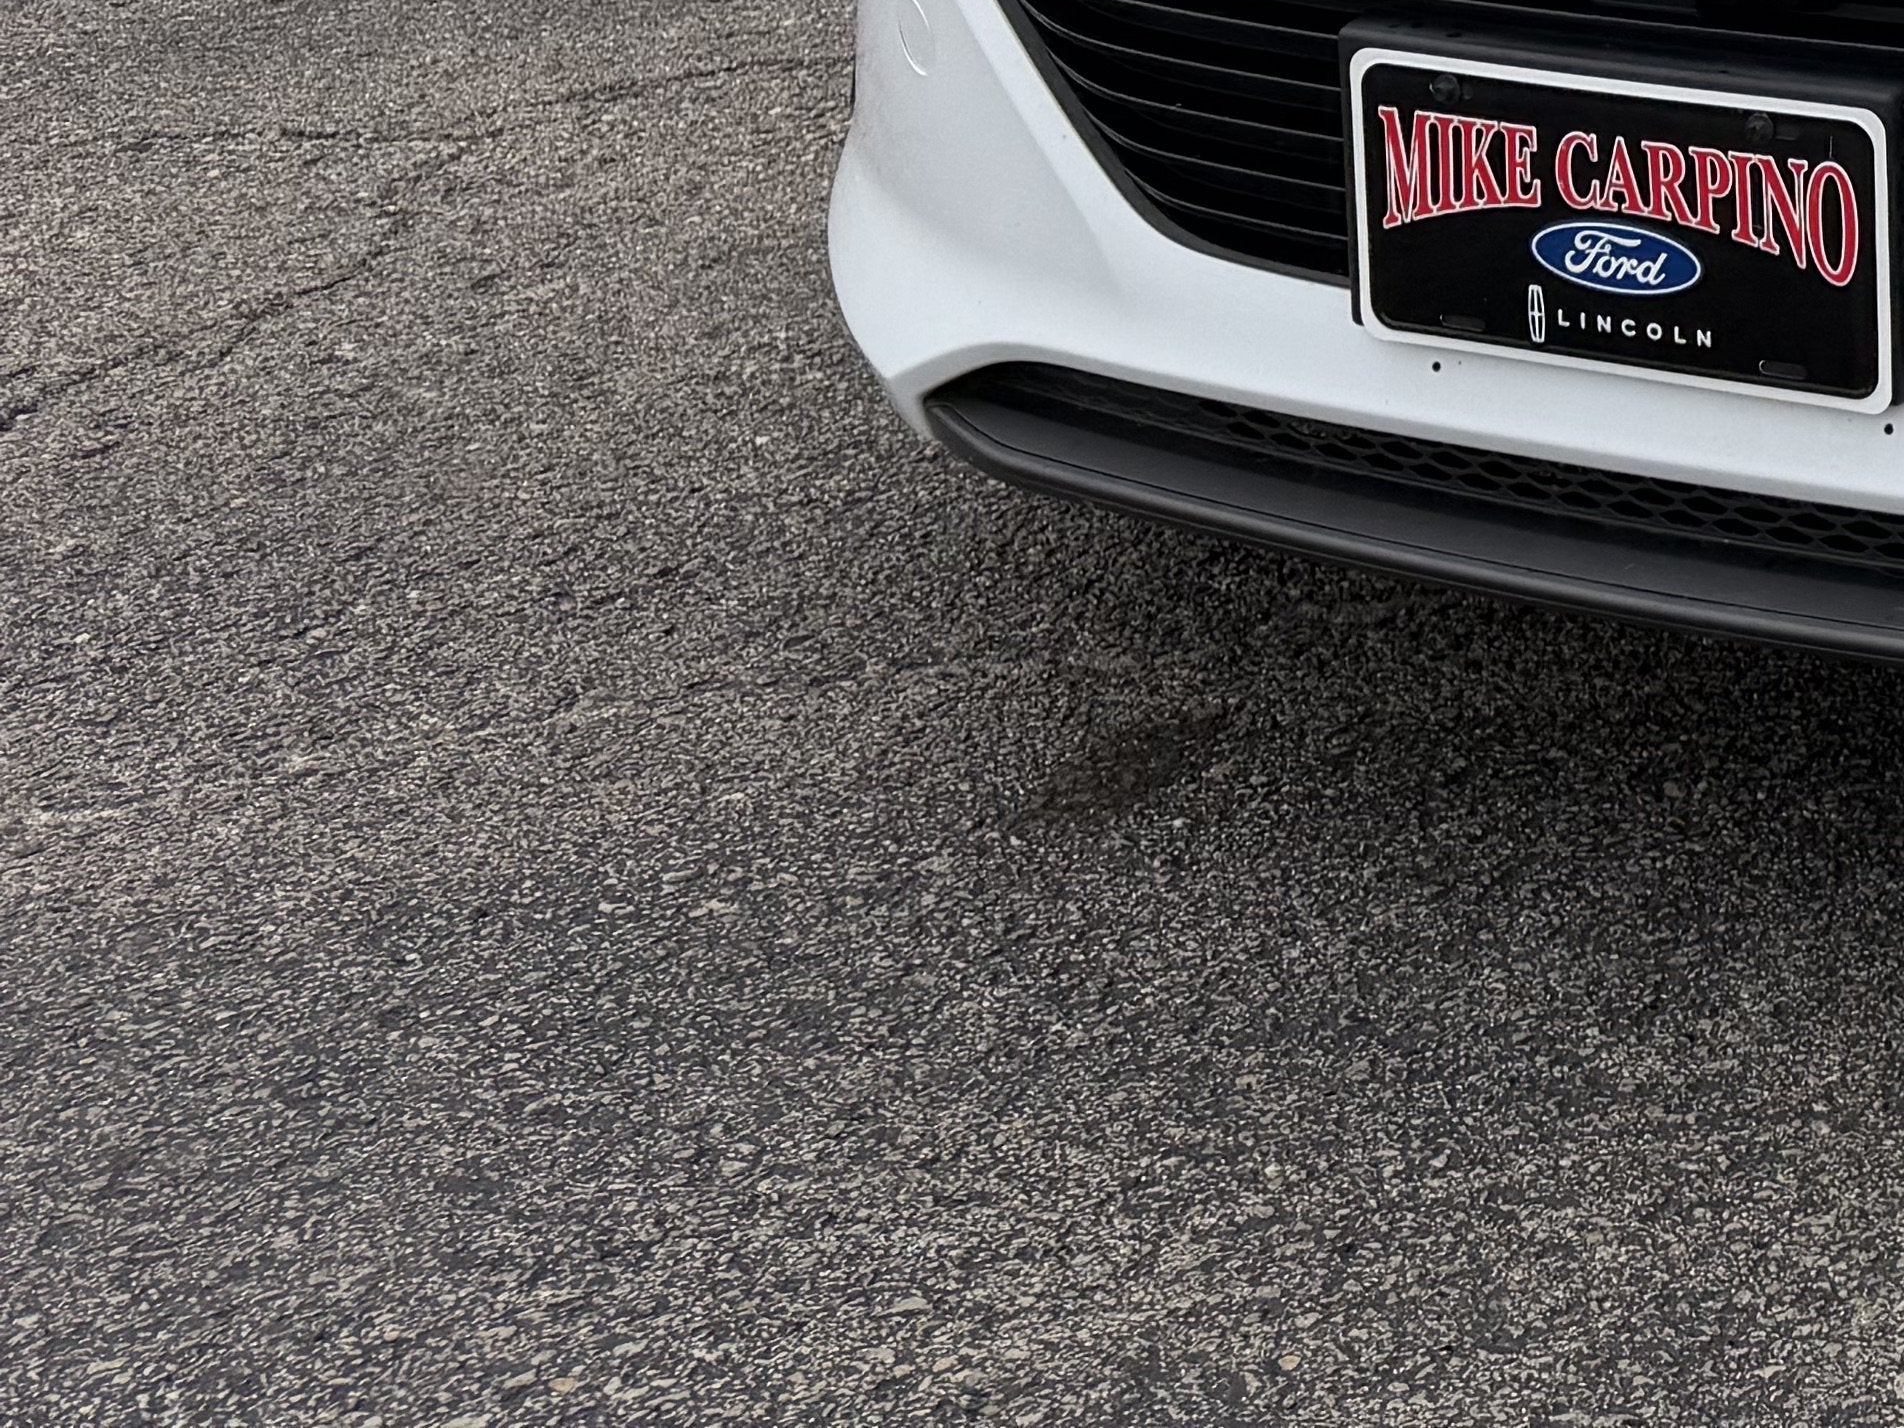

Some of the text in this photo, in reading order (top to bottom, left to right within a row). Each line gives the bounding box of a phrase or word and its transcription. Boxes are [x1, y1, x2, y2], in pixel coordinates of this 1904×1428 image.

[1377, 105, 1860, 288] MIKE CARPINO
[1565, 229, 1668, 286] Ford
[1558, 309, 1713, 349] LINCOLN
